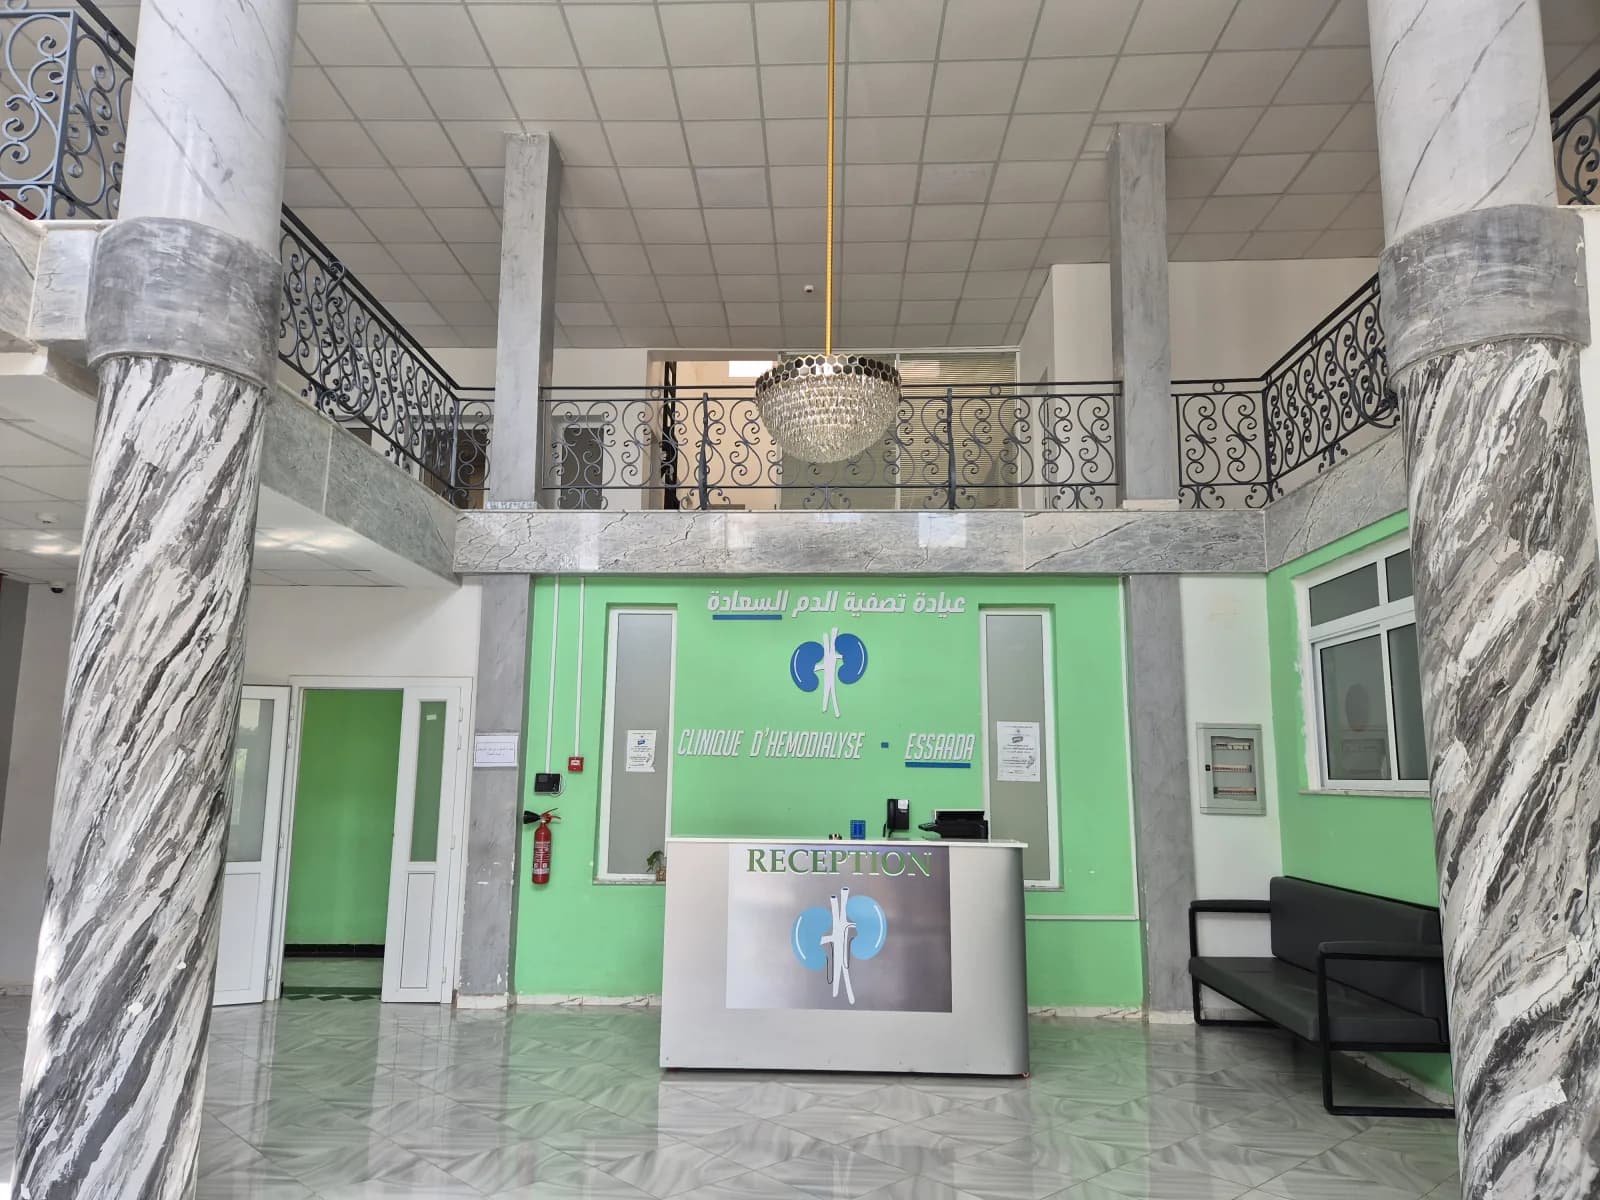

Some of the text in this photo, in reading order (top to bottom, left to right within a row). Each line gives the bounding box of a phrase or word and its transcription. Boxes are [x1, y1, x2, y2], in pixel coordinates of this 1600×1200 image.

[707, 590, 966, 618] عيادة تصفية الدم السعادة
[677, 728, 976, 761] CLINIQUE D'HEMODIALYSE ESSAADA
[746, 848, 932, 877] RECEPTION
